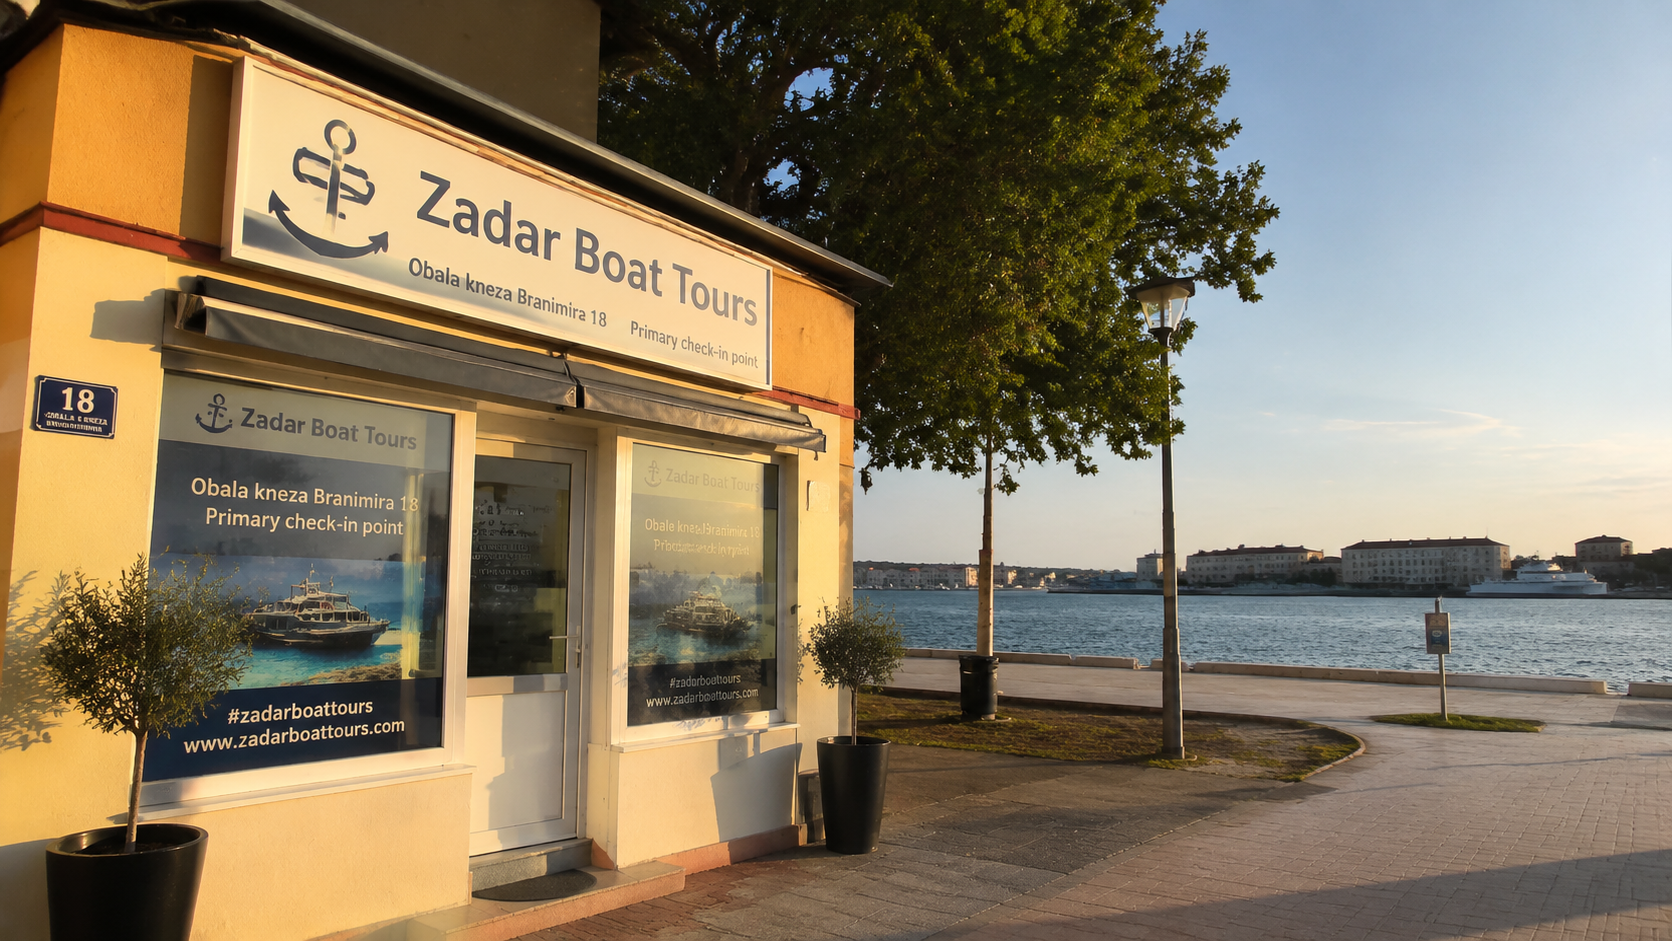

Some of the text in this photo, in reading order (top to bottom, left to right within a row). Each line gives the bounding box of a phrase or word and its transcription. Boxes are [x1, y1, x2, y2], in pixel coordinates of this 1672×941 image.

[417, 170, 758, 326] Zadar Boat Tours
[408, 257, 607, 328] Obala kneza Branimira 18
[631, 320, 758, 369] Primary check-in point
[62, 386, 95, 414] 18
[240, 406, 417, 451] Zadar Boat Tours
[191, 477, 419, 513] Obala kneza Branimira 18
[665, 468, 761, 493] Zadar Boat Tours
[205, 507, 404, 537] Primary check-in point
[227, 700, 374, 725] #zadarboattours
[183, 718, 405, 754] www.zadarboattours.com
